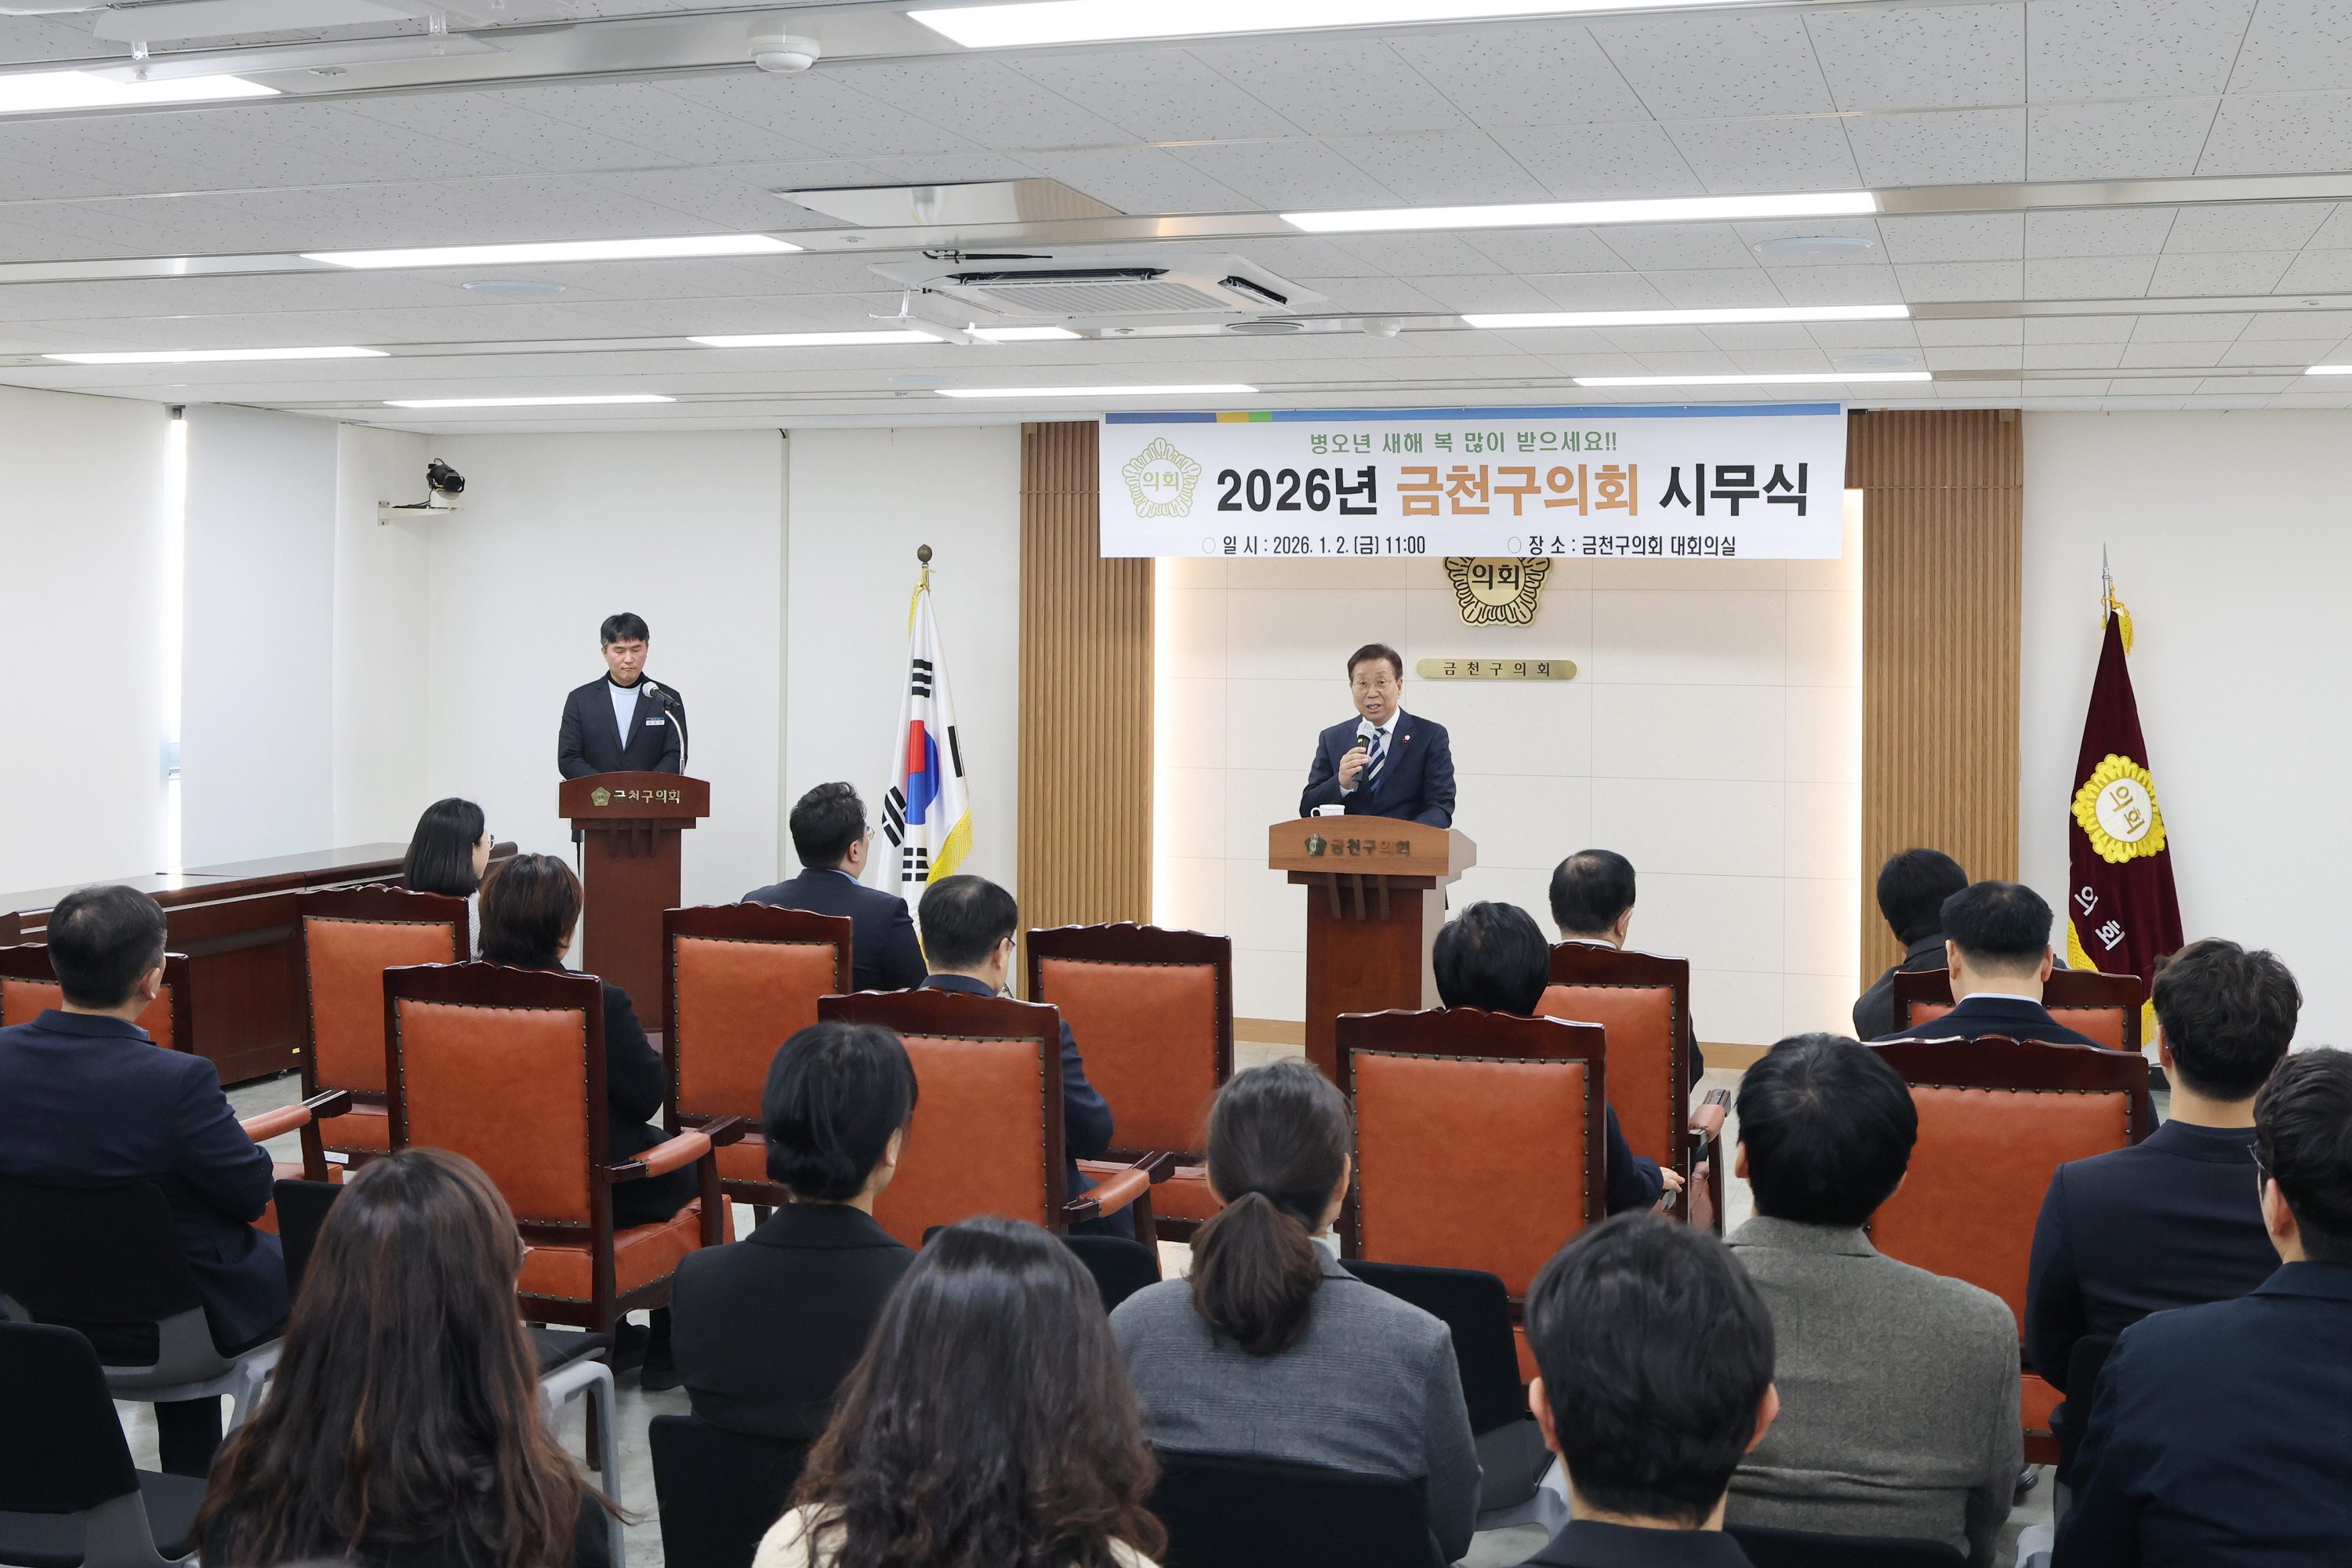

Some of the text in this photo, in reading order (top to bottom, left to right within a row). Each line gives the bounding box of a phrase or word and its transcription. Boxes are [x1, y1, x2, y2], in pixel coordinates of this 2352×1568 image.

[1311, 431, 1617, 455] 병오년 새해 복 많이 받으세요!!
[1142, 471, 1179, 492] 의회
[1217, 462, 1809, 517] 2026년 금천구의회 시무식
[1223, 535, 1236, 555] 일
[1243, 535, 1258, 555] 시
[1273, 535, 1313, 554] 2026.
[1319, 536, 1330, 554] 1.
[1336, 536, 1349, 554] 2.
[1354, 535, 1379, 555] (금)
[1385, 535, 1425, 554] 11:00
[1529, 535, 1544, 556] 장
[1551, 535, 1566, 554] 소
[1582, 535, 1663, 556] 금천구의회
[1671, 535, 1736, 557] 대회의실
[1472, 564, 1519, 590] 의회
[1443, 661, 1550, 677] 금천구의회
